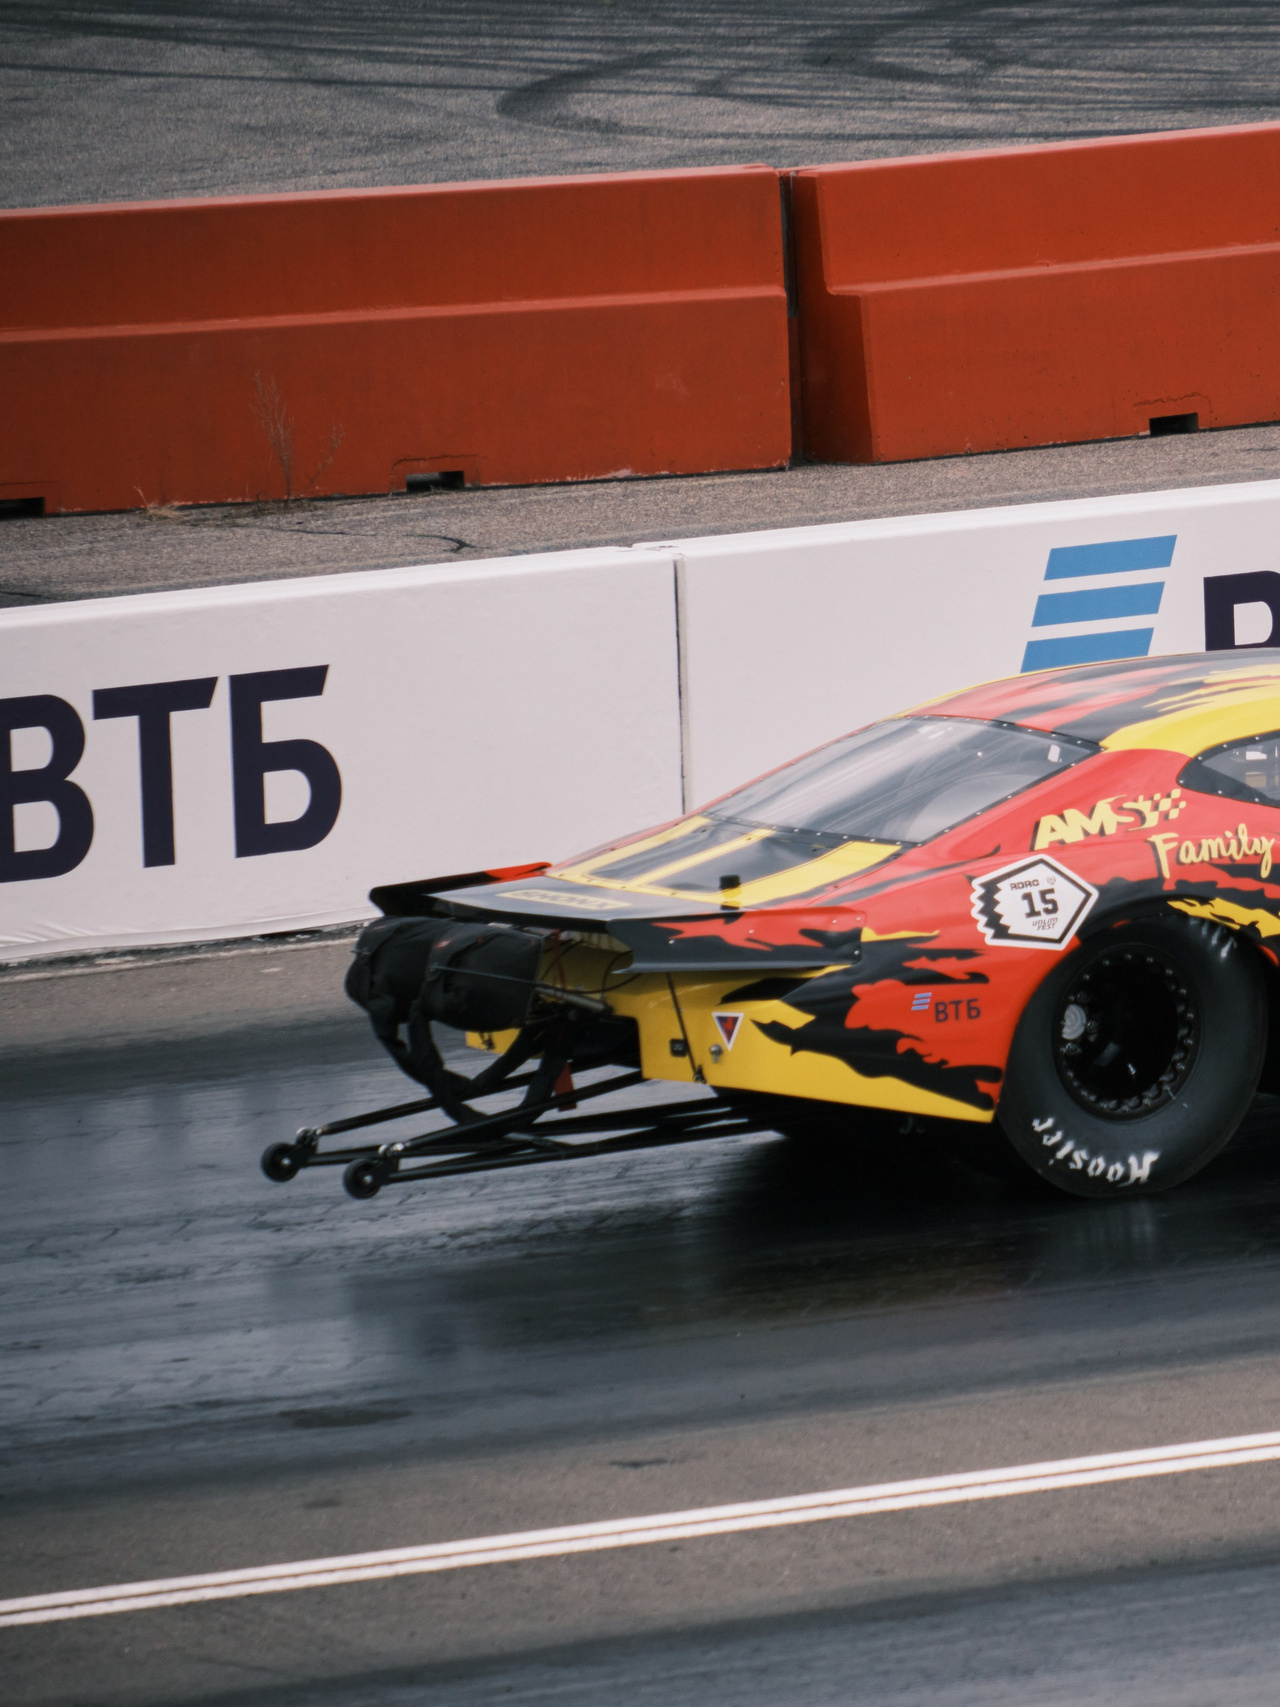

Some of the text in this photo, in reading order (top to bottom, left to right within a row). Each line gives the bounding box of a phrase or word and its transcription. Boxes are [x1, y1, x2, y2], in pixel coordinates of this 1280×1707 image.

[0, 664, 343, 882] ВТБ
[1033, 789, 1186, 851] AMS
[1148, 823, 1275, 879] Family
[1010, 879, 1040, 891] RDRC
[1021, 888, 1059, 918] 15
[1037, 923, 1056, 931] FEST
[934, 998, 982, 1023] ВТБ
